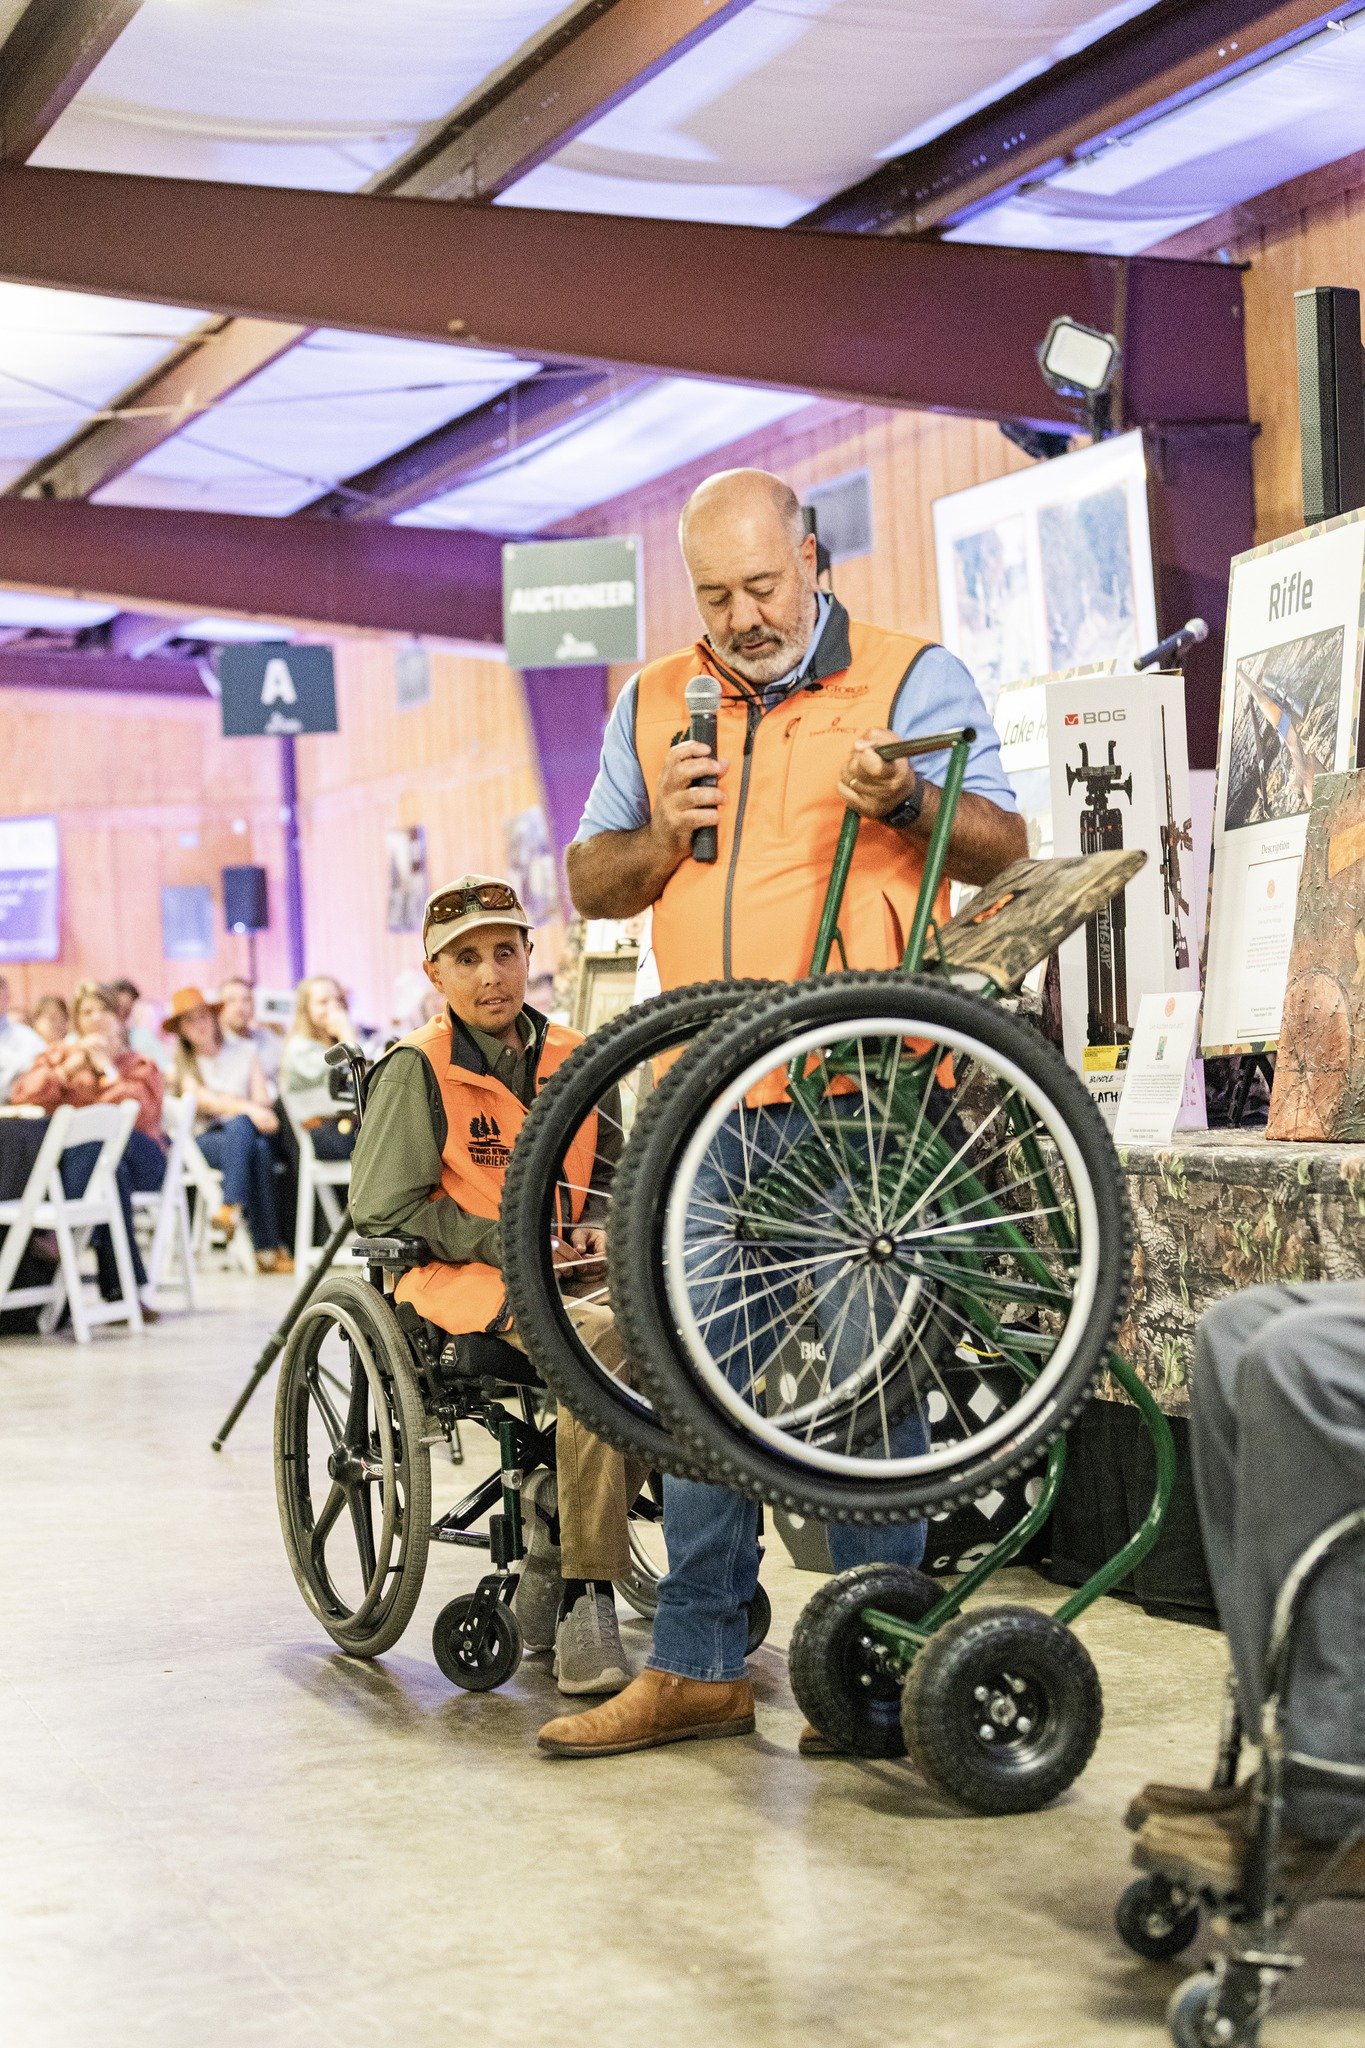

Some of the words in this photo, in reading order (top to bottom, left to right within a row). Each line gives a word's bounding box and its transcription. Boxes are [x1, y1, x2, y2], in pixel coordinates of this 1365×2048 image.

[509, 580, 635, 615] AUCTIONEER
[1268, 570, 1313, 622] Rifle
[260, 658, 298, 706] A
[1003, 716, 1035, 747] Lake
[1083, 709, 1126, 725] BOG
[1261, 840, 1290, 855] Description
[801, 1341, 827, 1361] BIG
